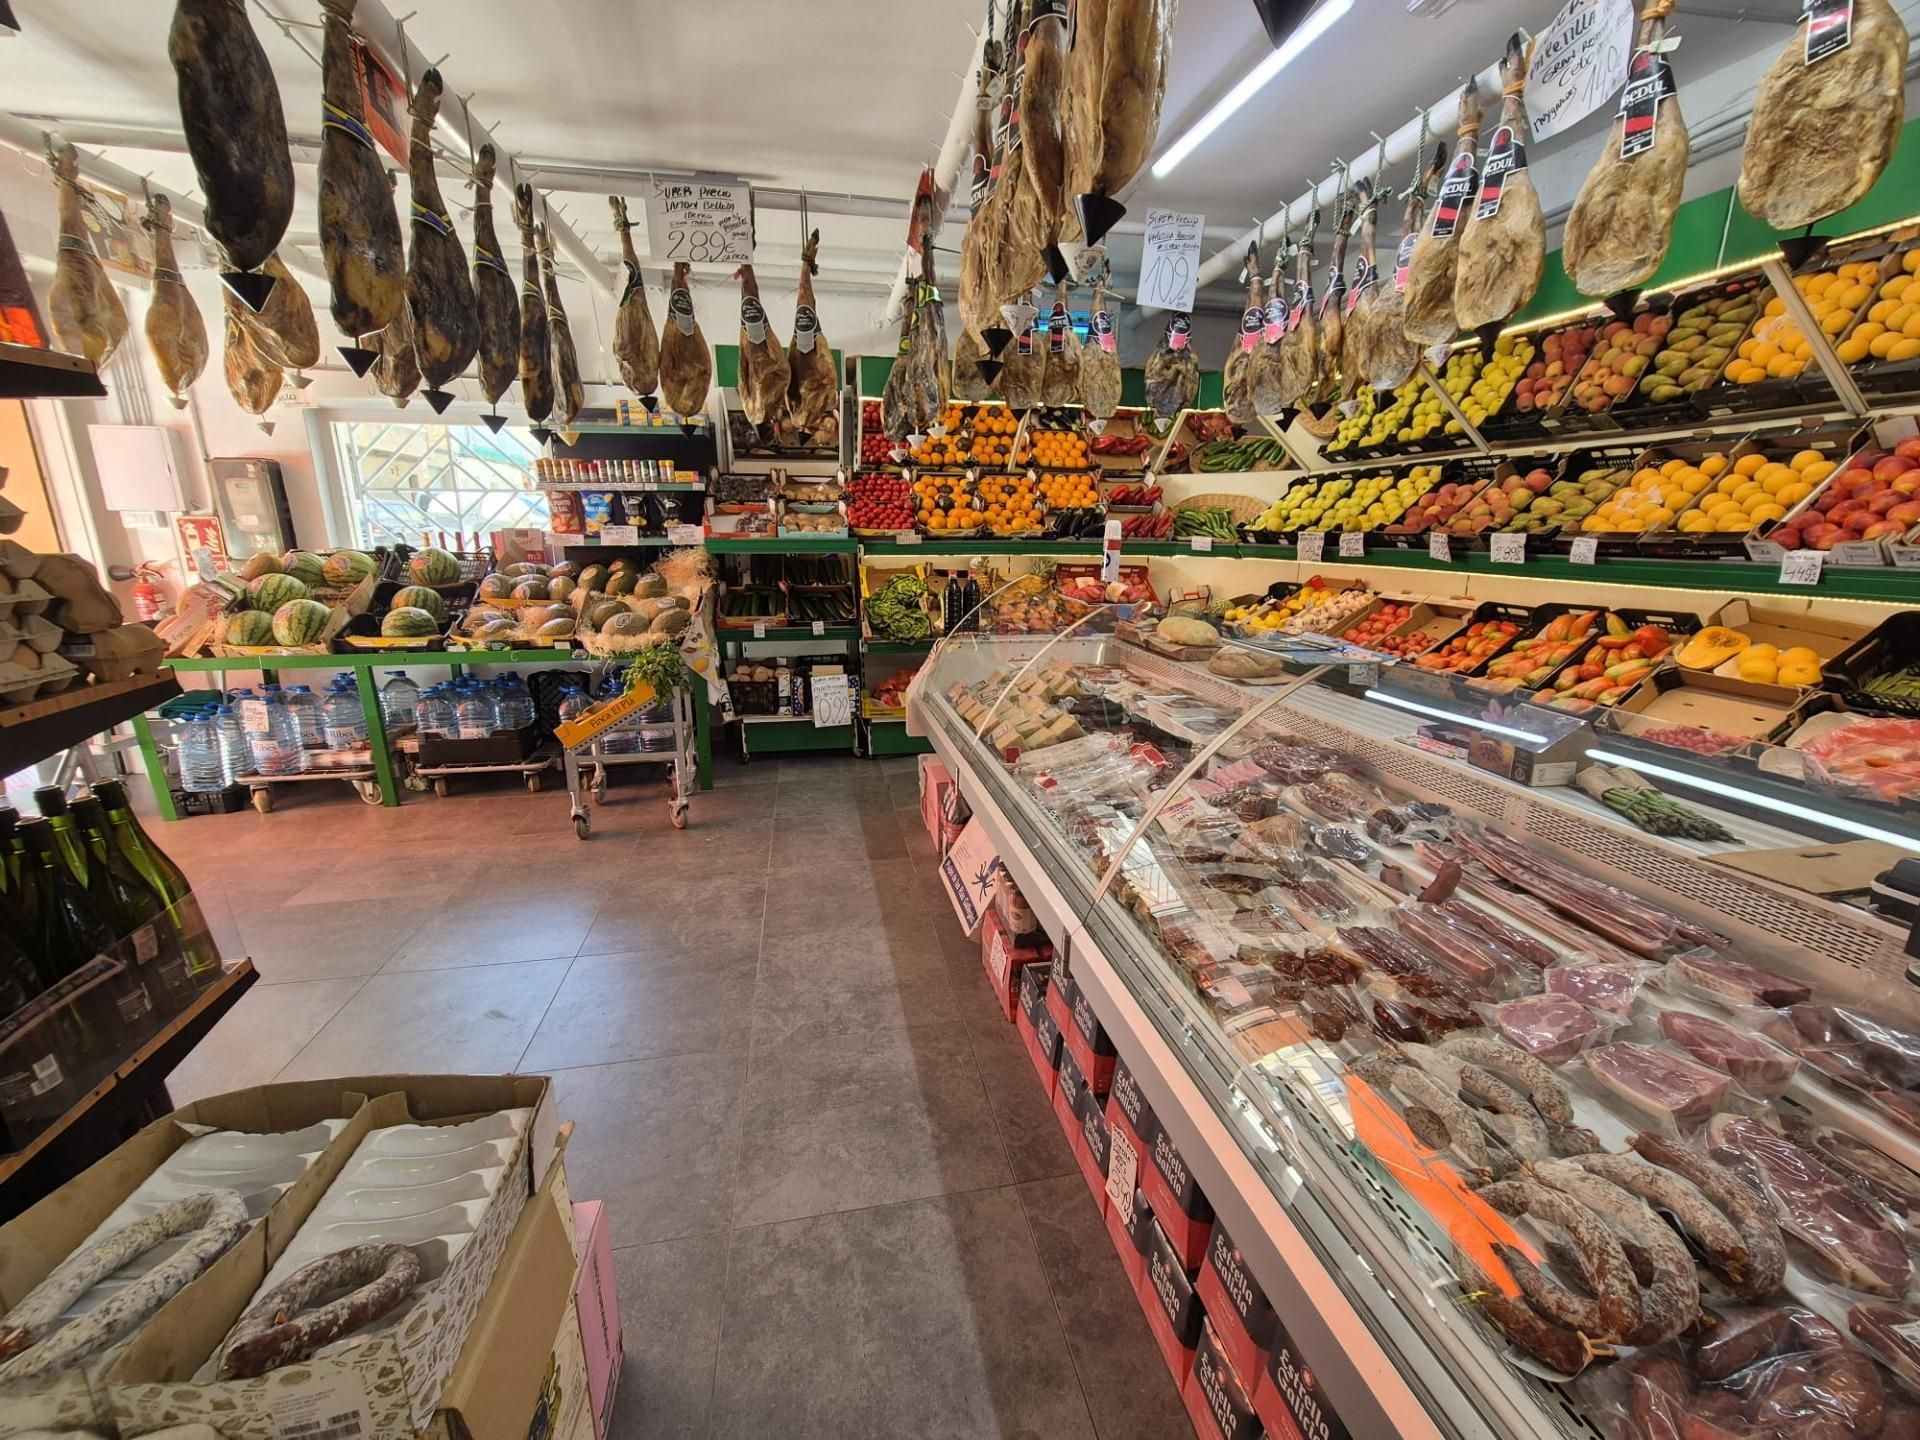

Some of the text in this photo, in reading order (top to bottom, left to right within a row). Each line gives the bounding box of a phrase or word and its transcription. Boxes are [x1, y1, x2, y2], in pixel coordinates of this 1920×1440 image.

[1115, 1084, 1137, 1124] Galicia
[1117, 1069, 1141, 1113] Estrella
[1155, 1147, 1182, 1197] Galicia
[1157, 1132, 1186, 1185] Estrella
[1151, 1266, 1176, 1322] Galicia
[1152, 1252, 1181, 1313] Estrella
[1214, 1250, 1247, 1318] Galicia
[1215, 1234, 1253, 1306] Estrella
[1200, 1366, 1232, 1440] Galicia
[1201, 1352, 1238, 1431] Estrella
[1279, 1348, 1329, 1440] Estrella
